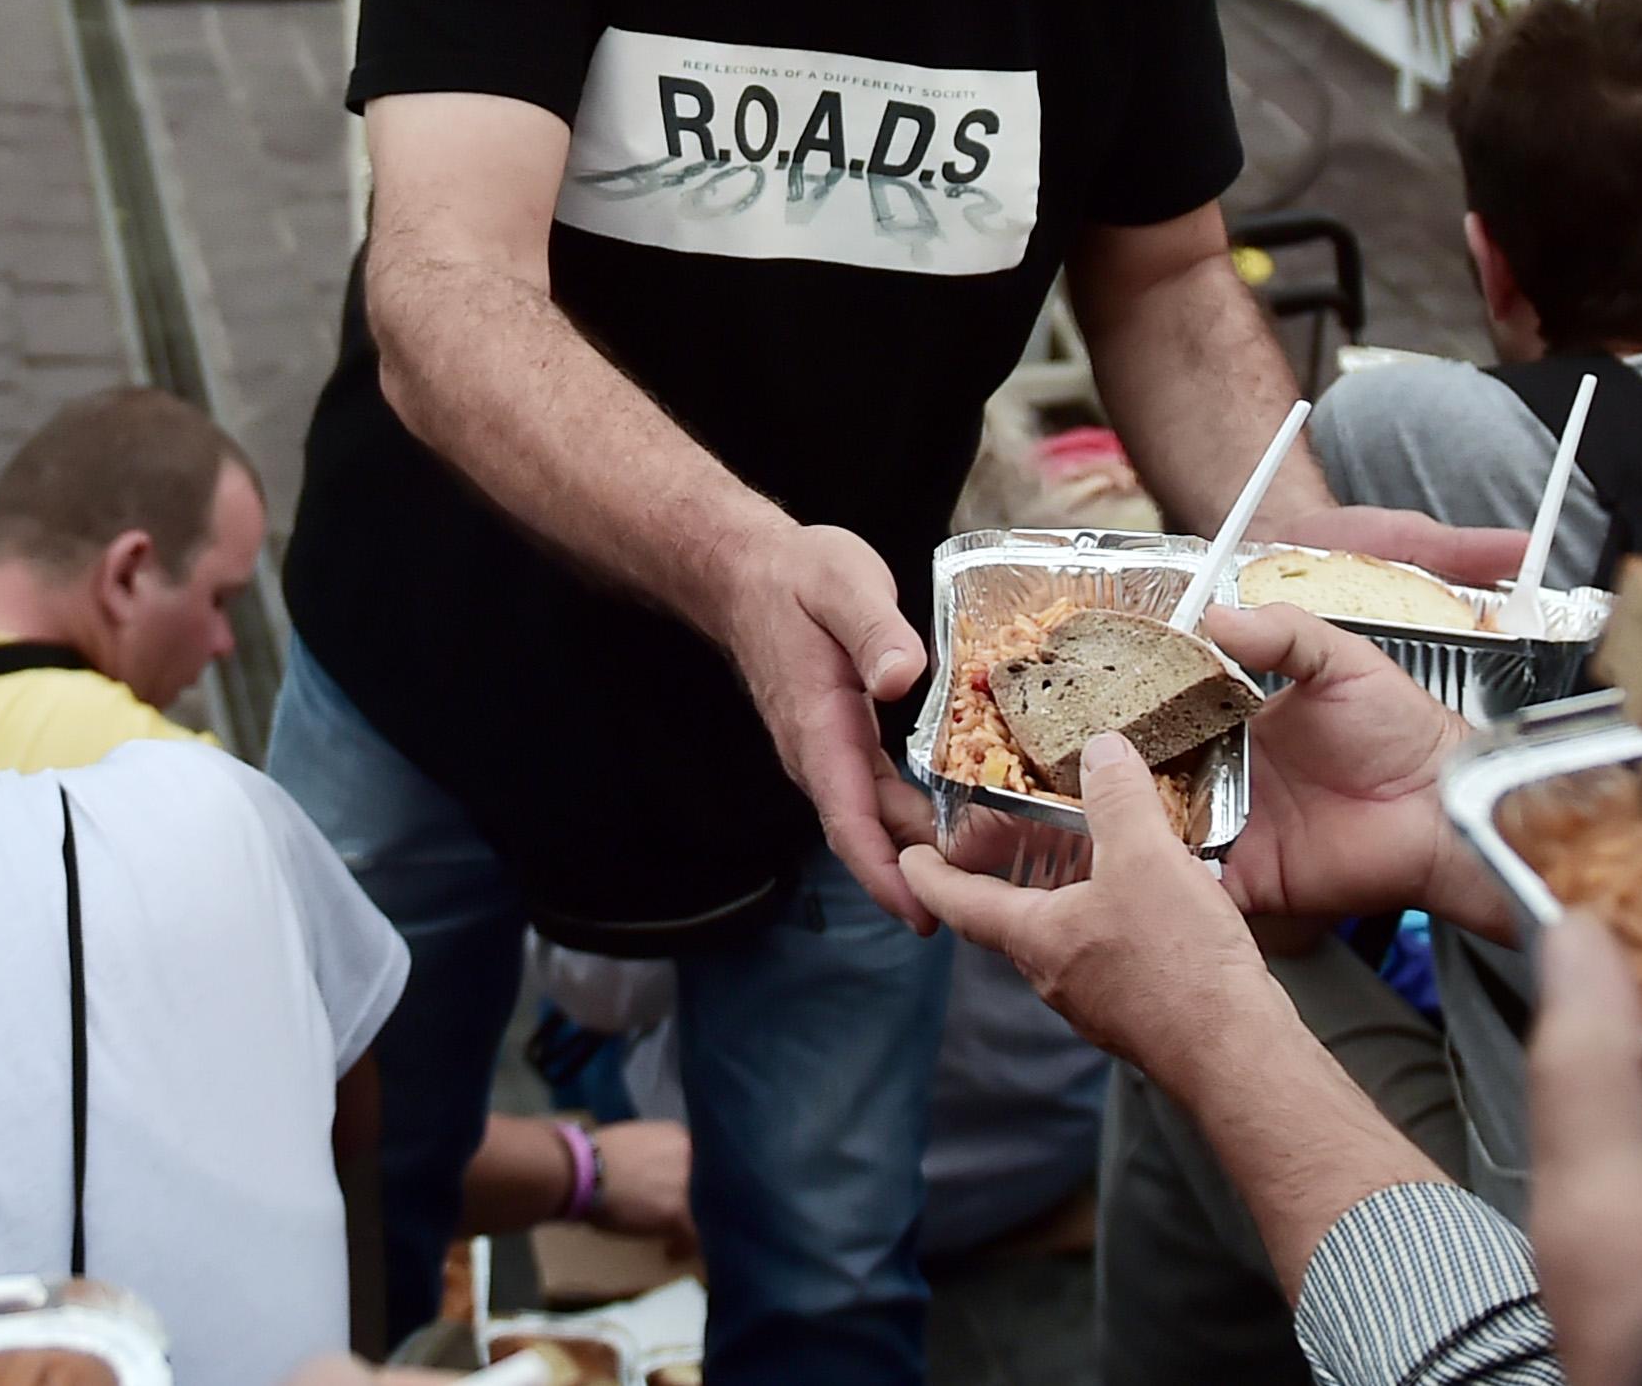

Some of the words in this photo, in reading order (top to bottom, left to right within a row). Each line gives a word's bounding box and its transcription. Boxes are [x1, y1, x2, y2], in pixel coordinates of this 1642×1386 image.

[683, 59, 779, 78] REFLECTIONS
[785, 69, 803, 79] OF
[808, 71, 818, 80] A
[824, 73, 916, 96] DIFFERENT
[921, 87, 977, 100] SOCIETY
[658, 75, 1000, 184] R.O.A.D.S
